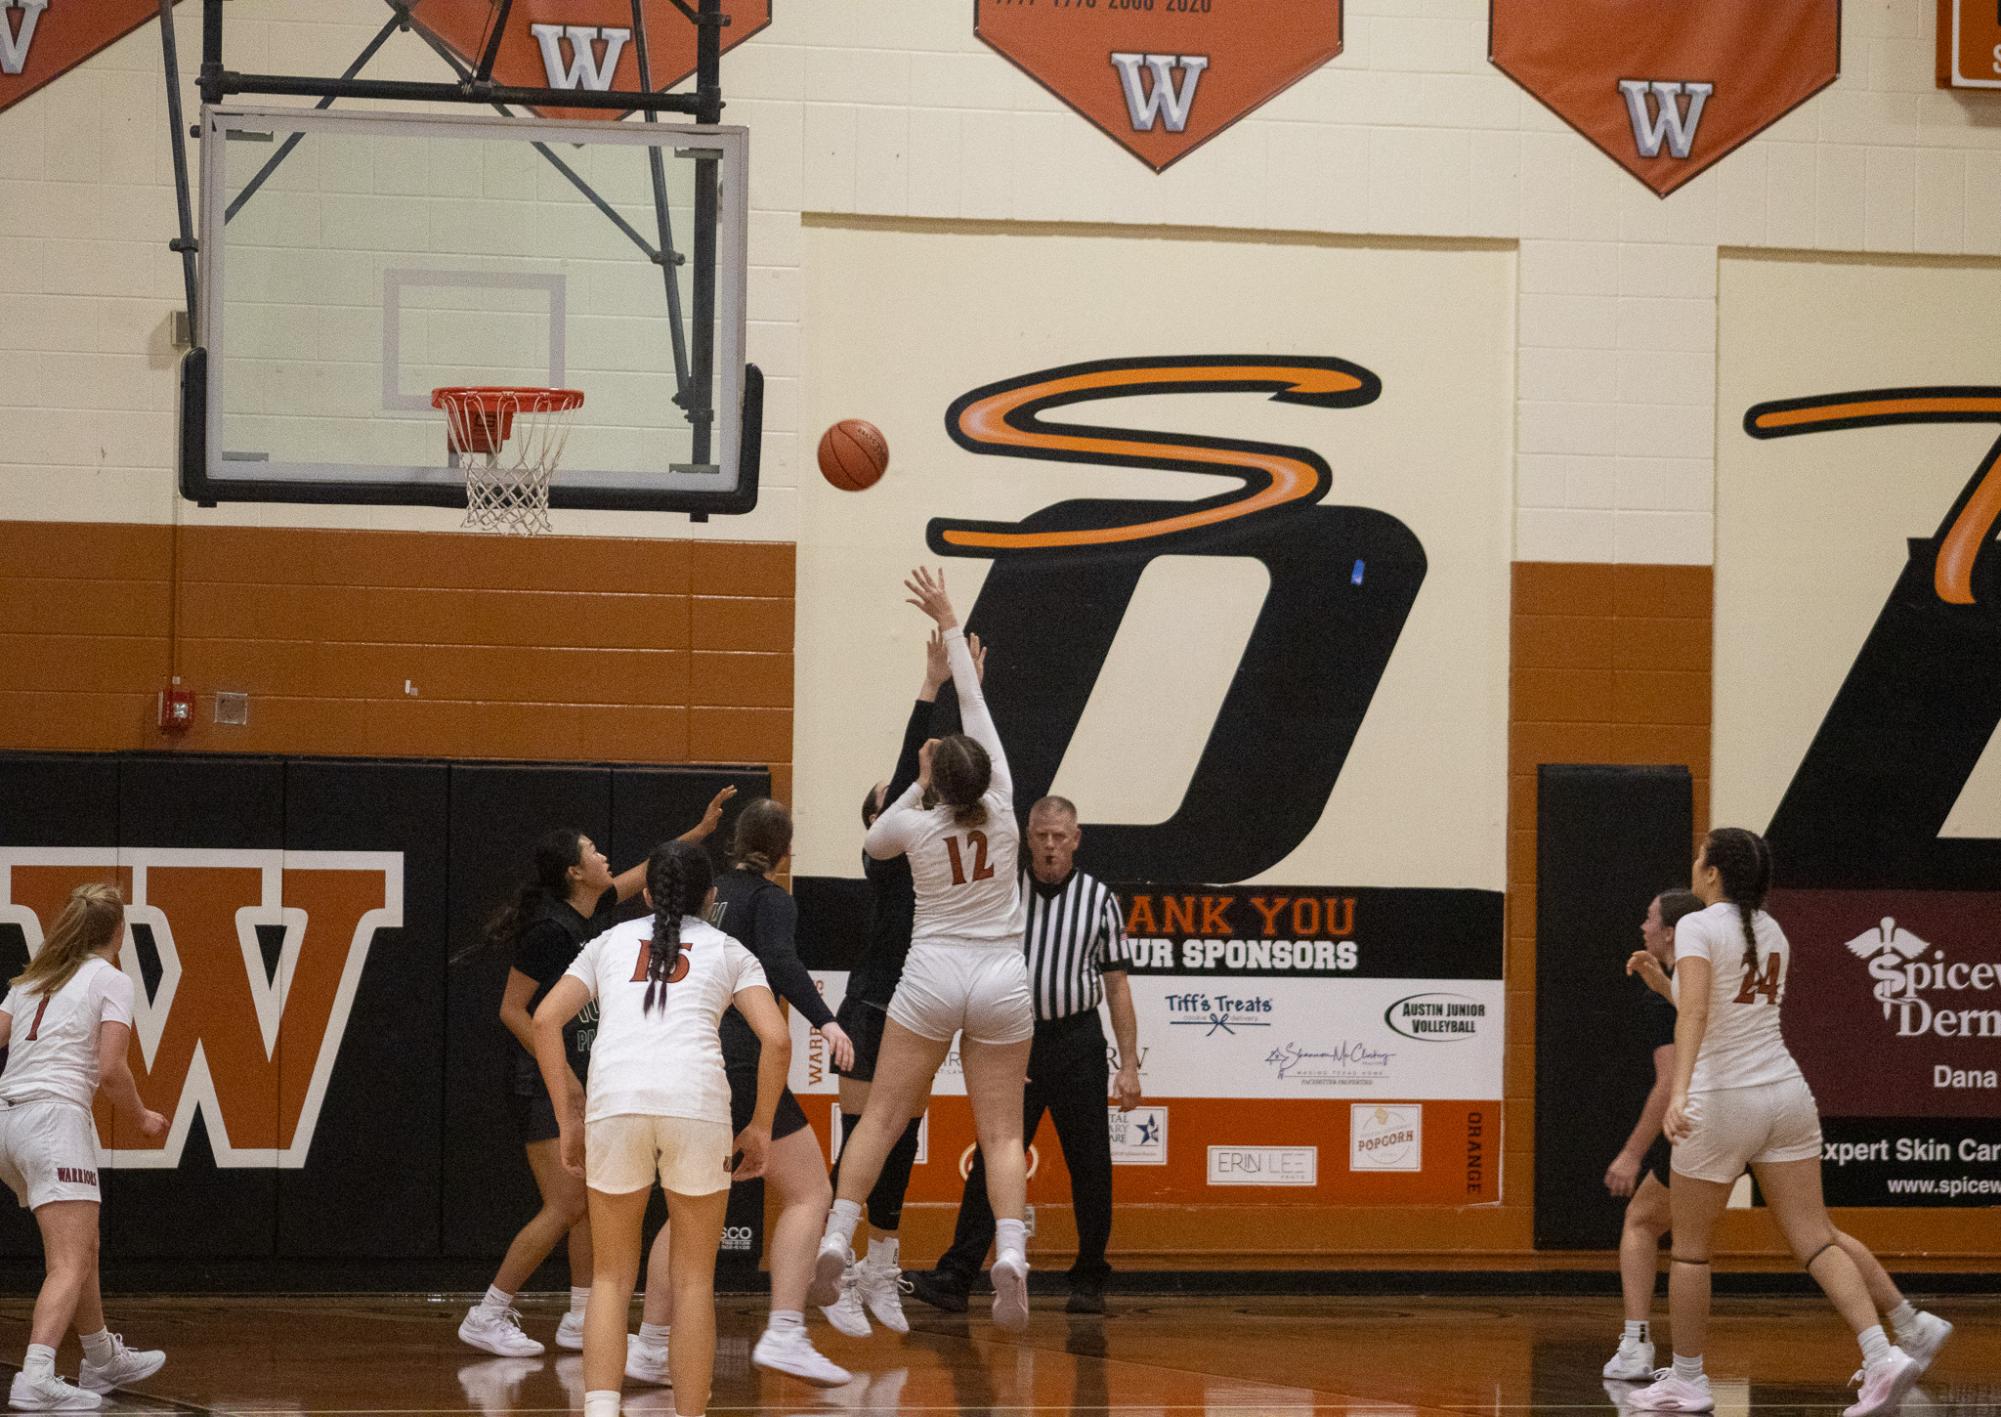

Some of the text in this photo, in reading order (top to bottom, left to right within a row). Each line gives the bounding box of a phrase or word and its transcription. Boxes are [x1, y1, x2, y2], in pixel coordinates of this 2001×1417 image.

[531, 24, 631, 91] W
[1111, 53, 1208, 132] W
[1618, 80, 1713, 158] W
[942, 830, 995, 886] 12
[1117, 896, 1356, 936] ANK YOU
[629, 939, 694, 983] 15
[1127, 938, 1358, 970] UR SPONSORS
[1732, 952, 1781, 1005] 24
[1868, 950, 2001, 1002] Spice
[0, 846, 404, 1168] W
[1164, 993, 1272, 1012] Tiff's Treats
[1402, 1002, 1486, 1017] AUSTIN JUNIOR
[1412, 1019, 1476, 1033] VOLLEYBALL
[1934, 1065, 1997, 1088] Dana
[1358, 1130, 1414, 1152] POPCORN
[1467, 1112, 1482, 1195] ORANGE
[1821, 1139, 1888, 1166] xpert
[1896, 1138, 1950, 1162] Skin
[57, 1167, 97, 1186] WARRIORS
[1218, 1152, 1305, 1174] ERIN LEE
